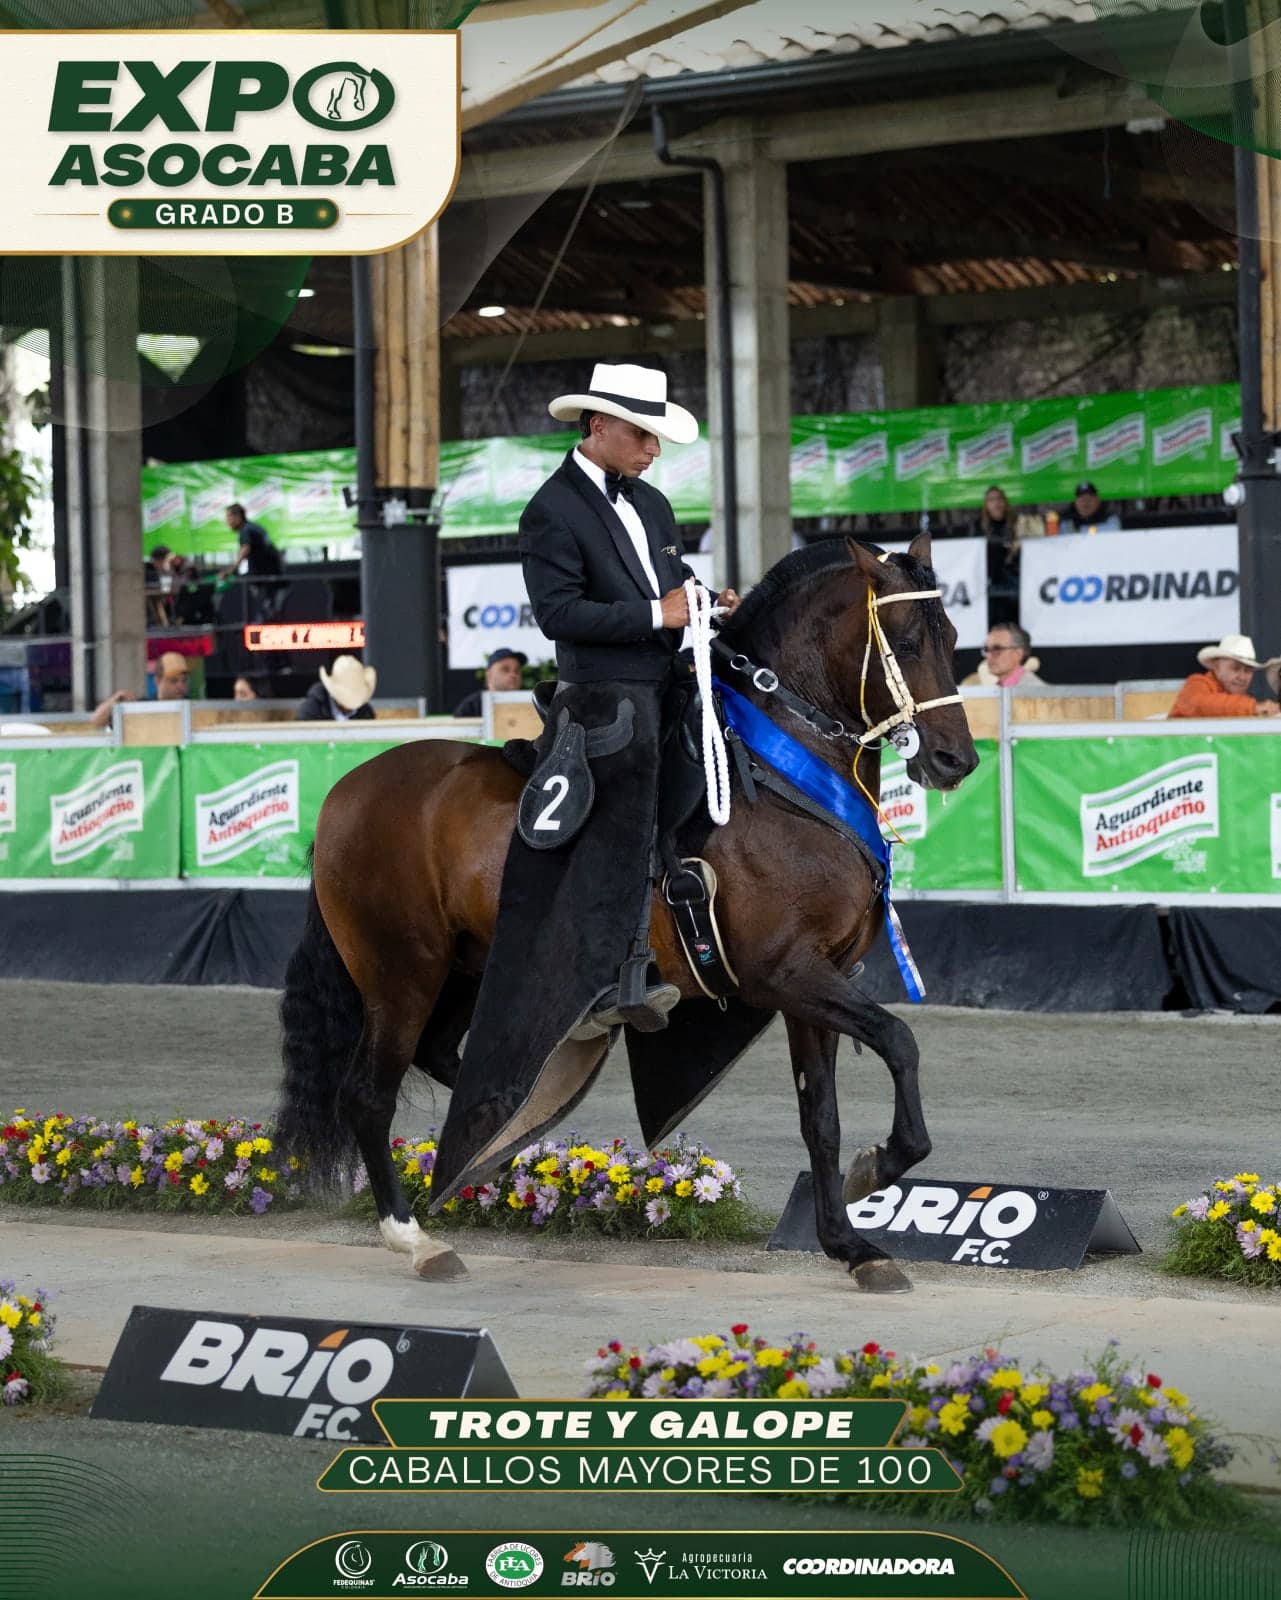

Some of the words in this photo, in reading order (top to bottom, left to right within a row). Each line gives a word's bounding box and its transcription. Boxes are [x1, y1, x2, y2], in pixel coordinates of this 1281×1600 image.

[533, 774, 570, 831] 2
[1096, 779, 1203, 831] Aguardiente
[1096, 797, 1206, 852] Antioqueño
[951, 1238, 1012, 1265] F.C.
